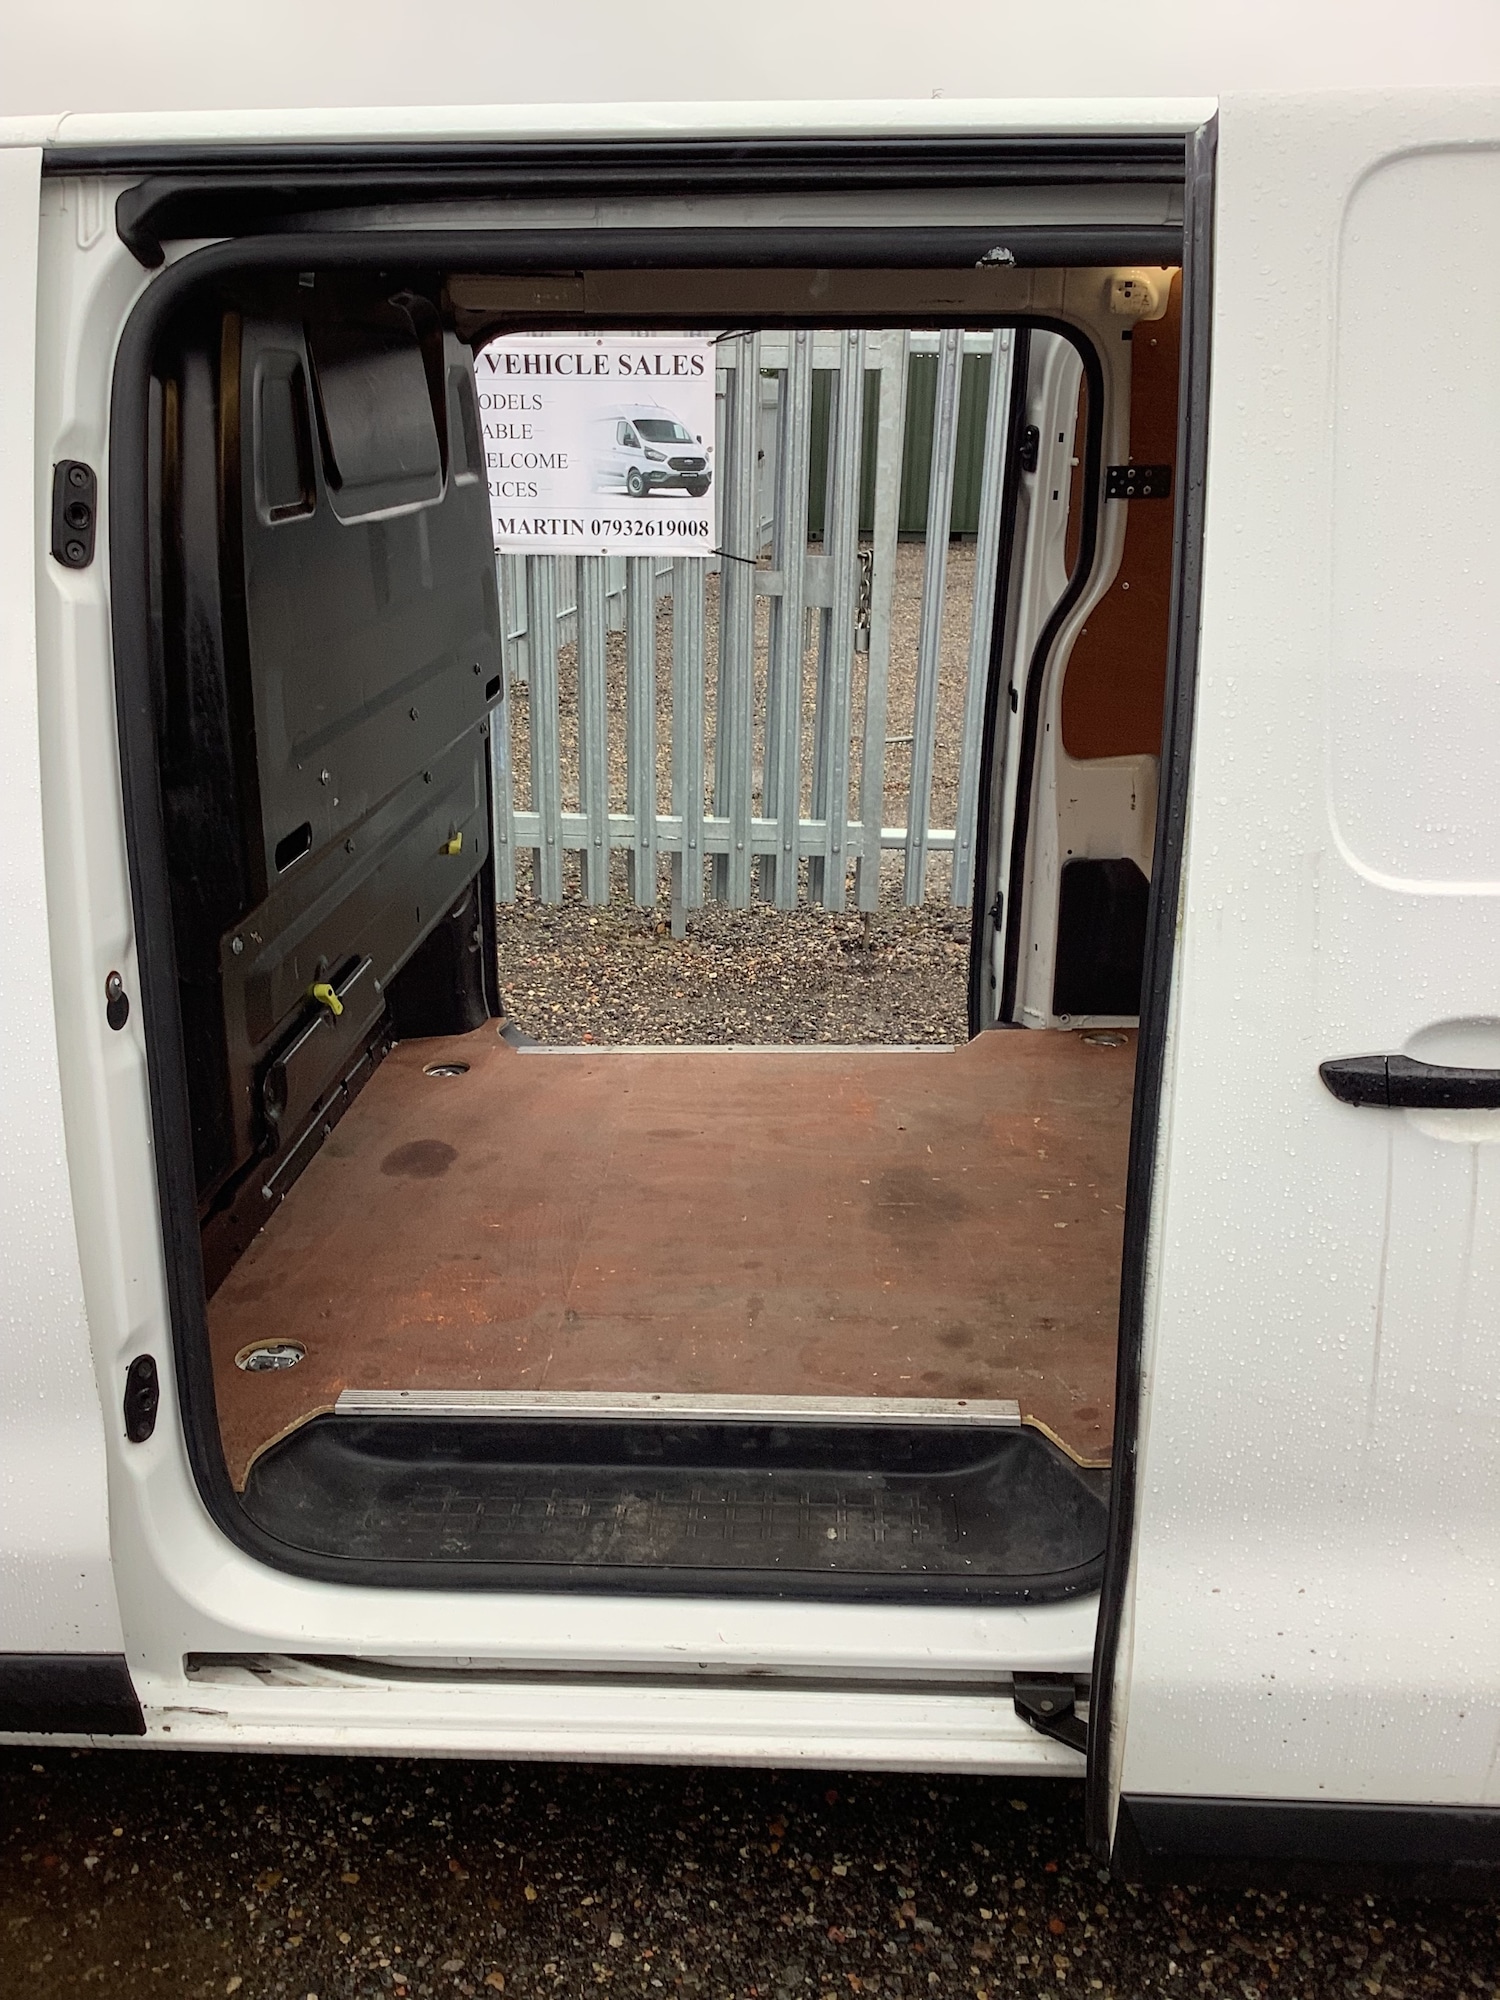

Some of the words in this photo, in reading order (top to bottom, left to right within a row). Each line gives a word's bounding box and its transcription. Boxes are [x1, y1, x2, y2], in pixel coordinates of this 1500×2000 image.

[483, 353, 610, 375] VEHICLE
[618, 353, 705, 375] SALES
[483, 423, 533, 440] ABLE
[486, 452, 568, 469] ELCOME
[497, 518, 584, 535] MARTIN
[590, 519, 709, 537] 07932619008
